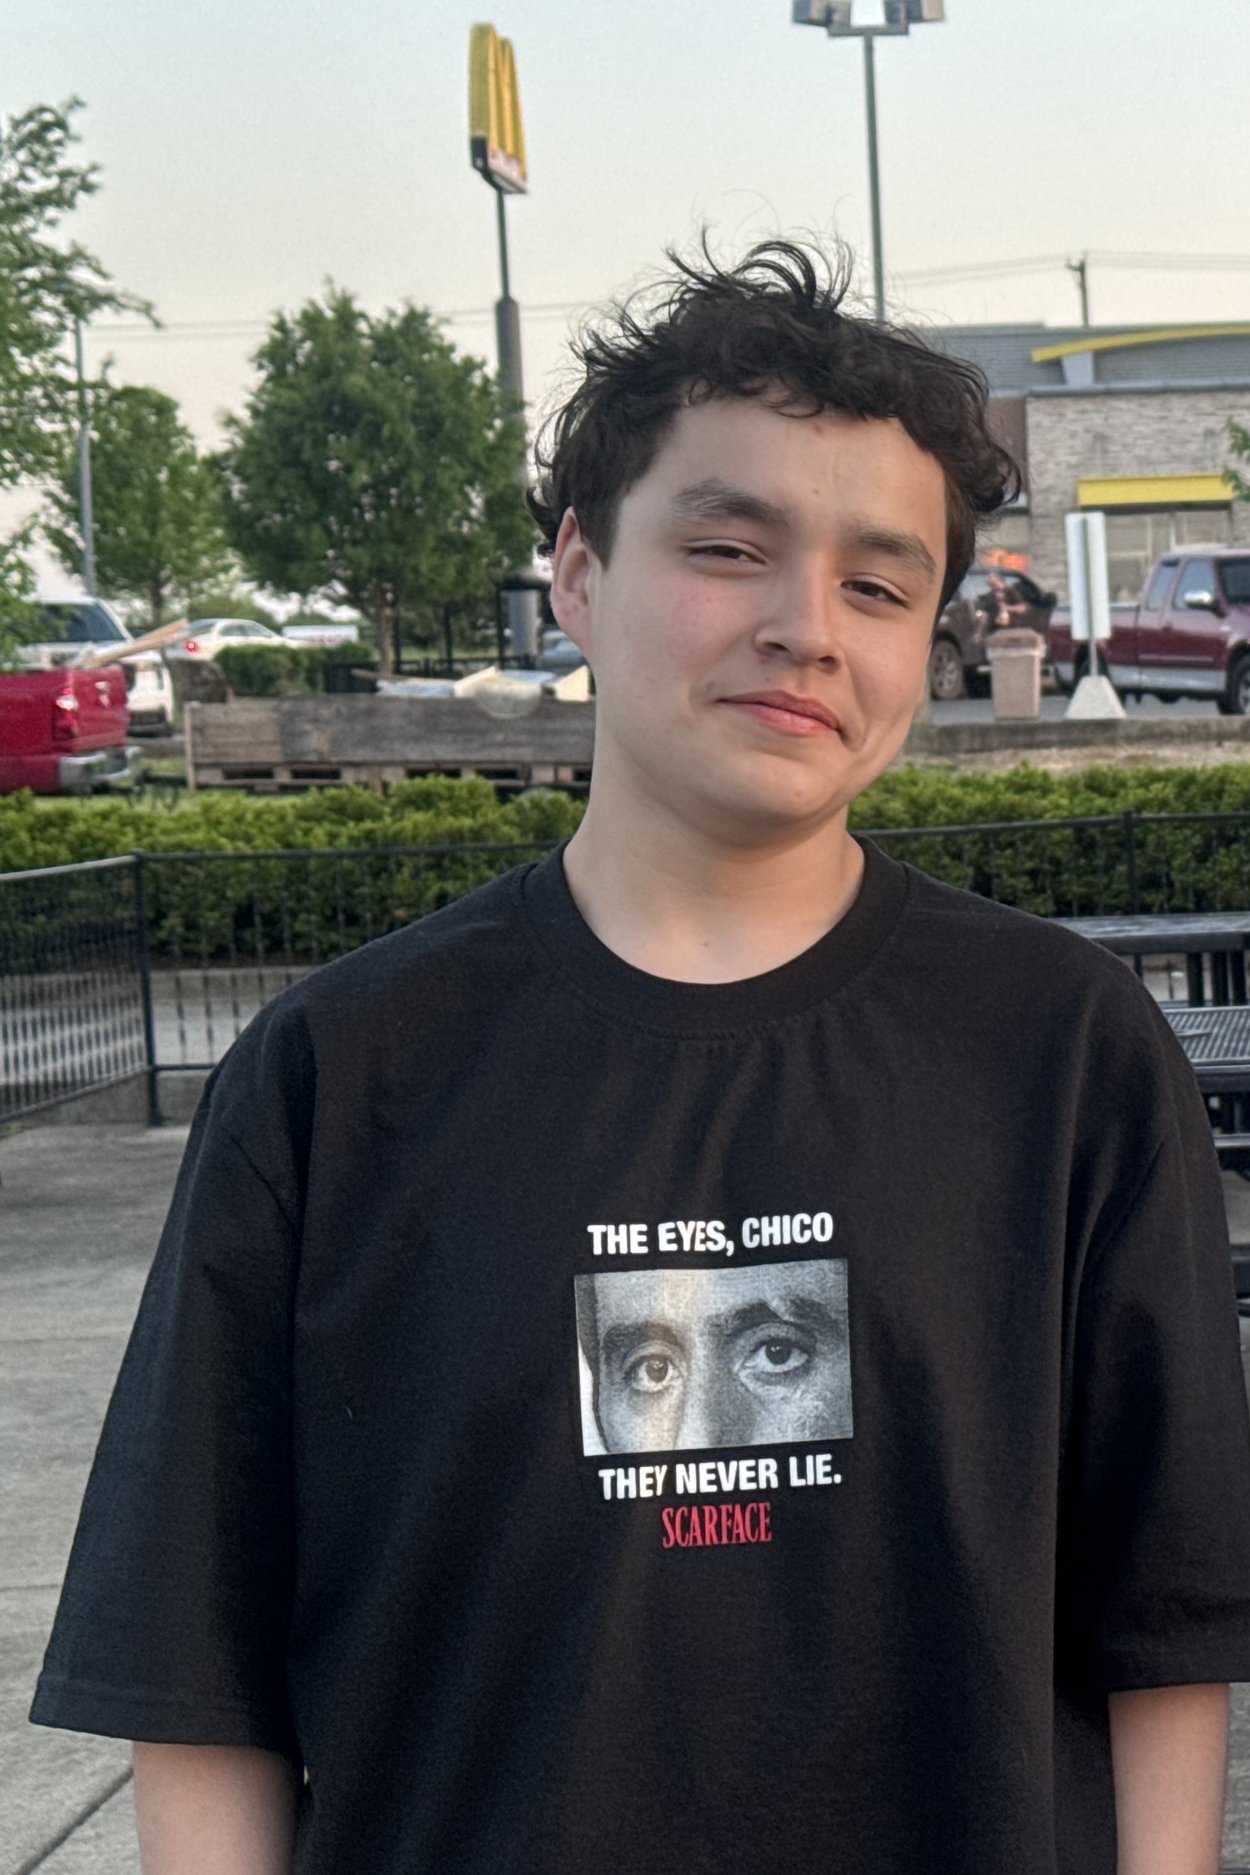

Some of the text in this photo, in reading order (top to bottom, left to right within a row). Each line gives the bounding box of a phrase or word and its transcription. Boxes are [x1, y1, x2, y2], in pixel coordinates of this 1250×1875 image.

[587, 1212, 834, 1257] THE EYES, CHICO
[598, 1454, 842, 1501] THEY NEVER LIE.
[662, 1502, 772, 1549] SCARFACE
